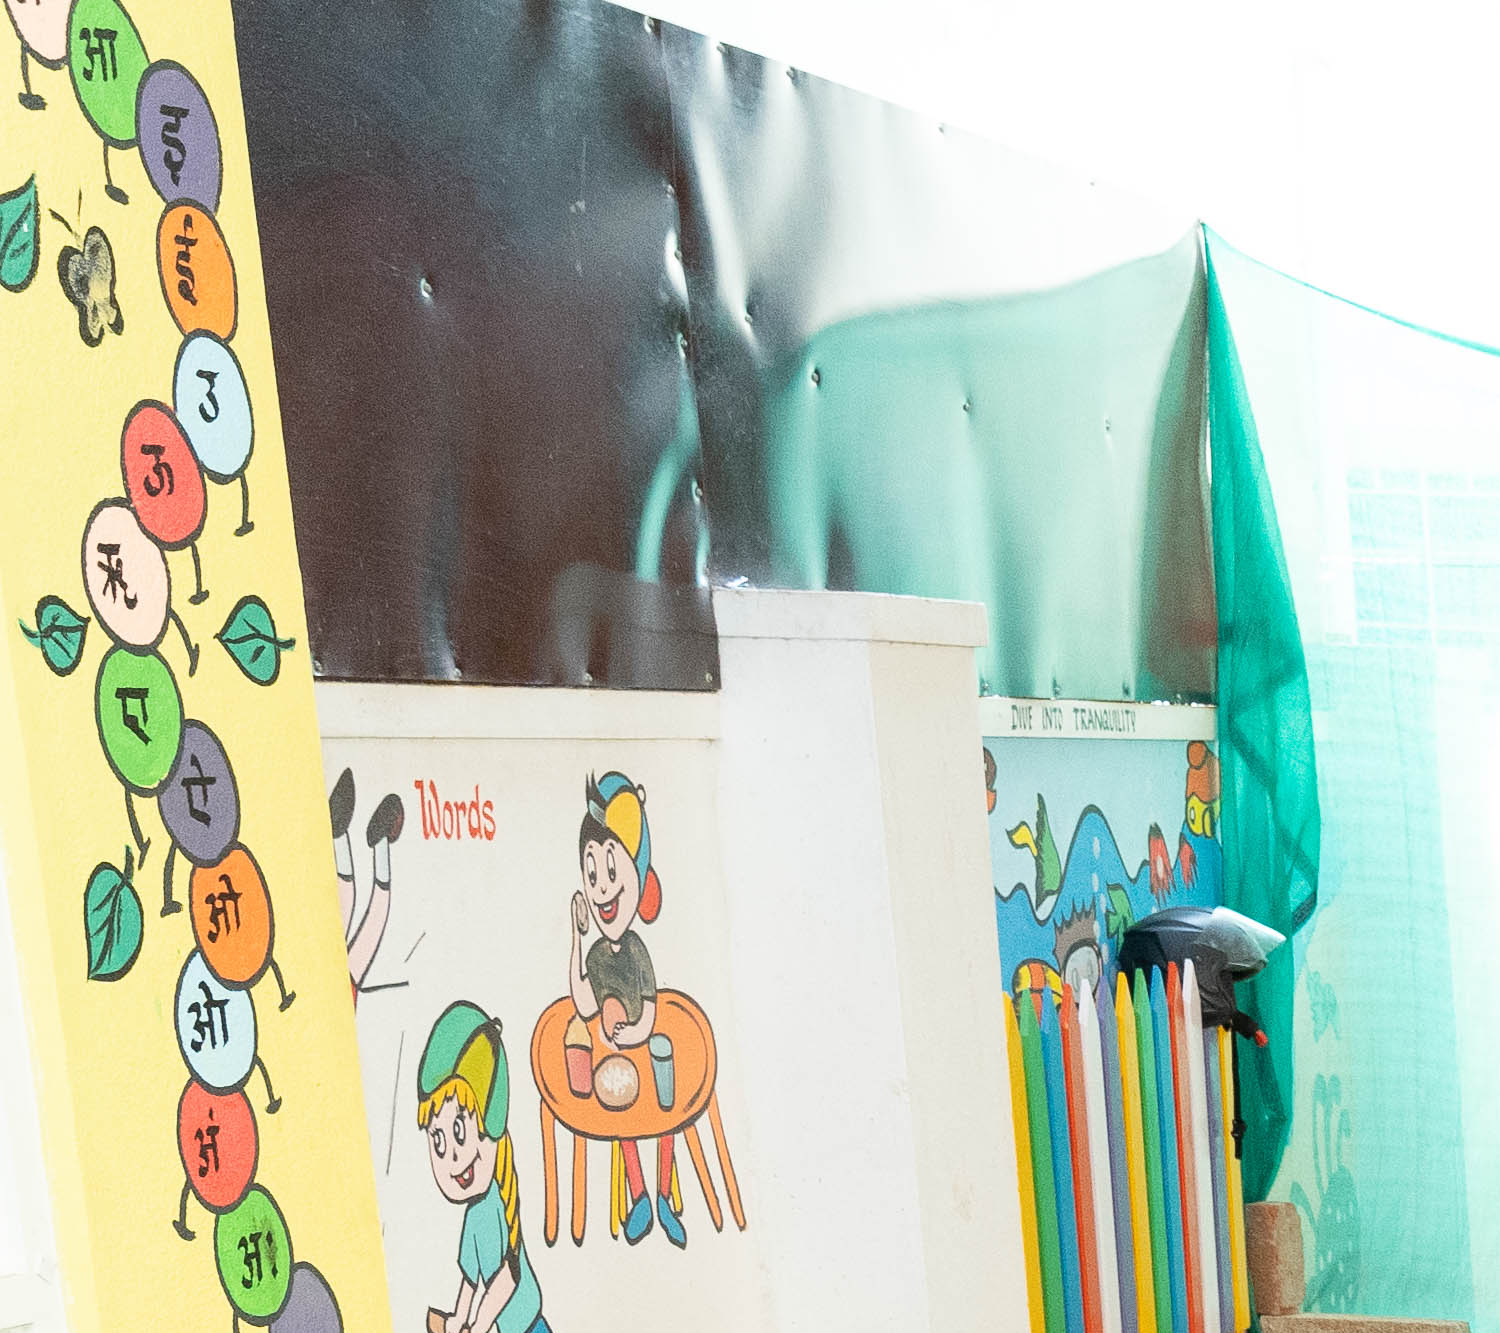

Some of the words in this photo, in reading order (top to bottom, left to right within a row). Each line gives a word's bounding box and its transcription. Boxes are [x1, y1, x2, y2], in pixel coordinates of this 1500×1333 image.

[79, 27, 117, 82] आ
[159, 103, 190, 187] इ
[195, 369, 220, 424] उ
[140, 444, 174, 497] ऊ
[96, 542, 139, 610] ऋ
[115, 687, 152, 747] ए
[180, 753, 217, 829] ऐ
[413, 777, 497, 842] Words
